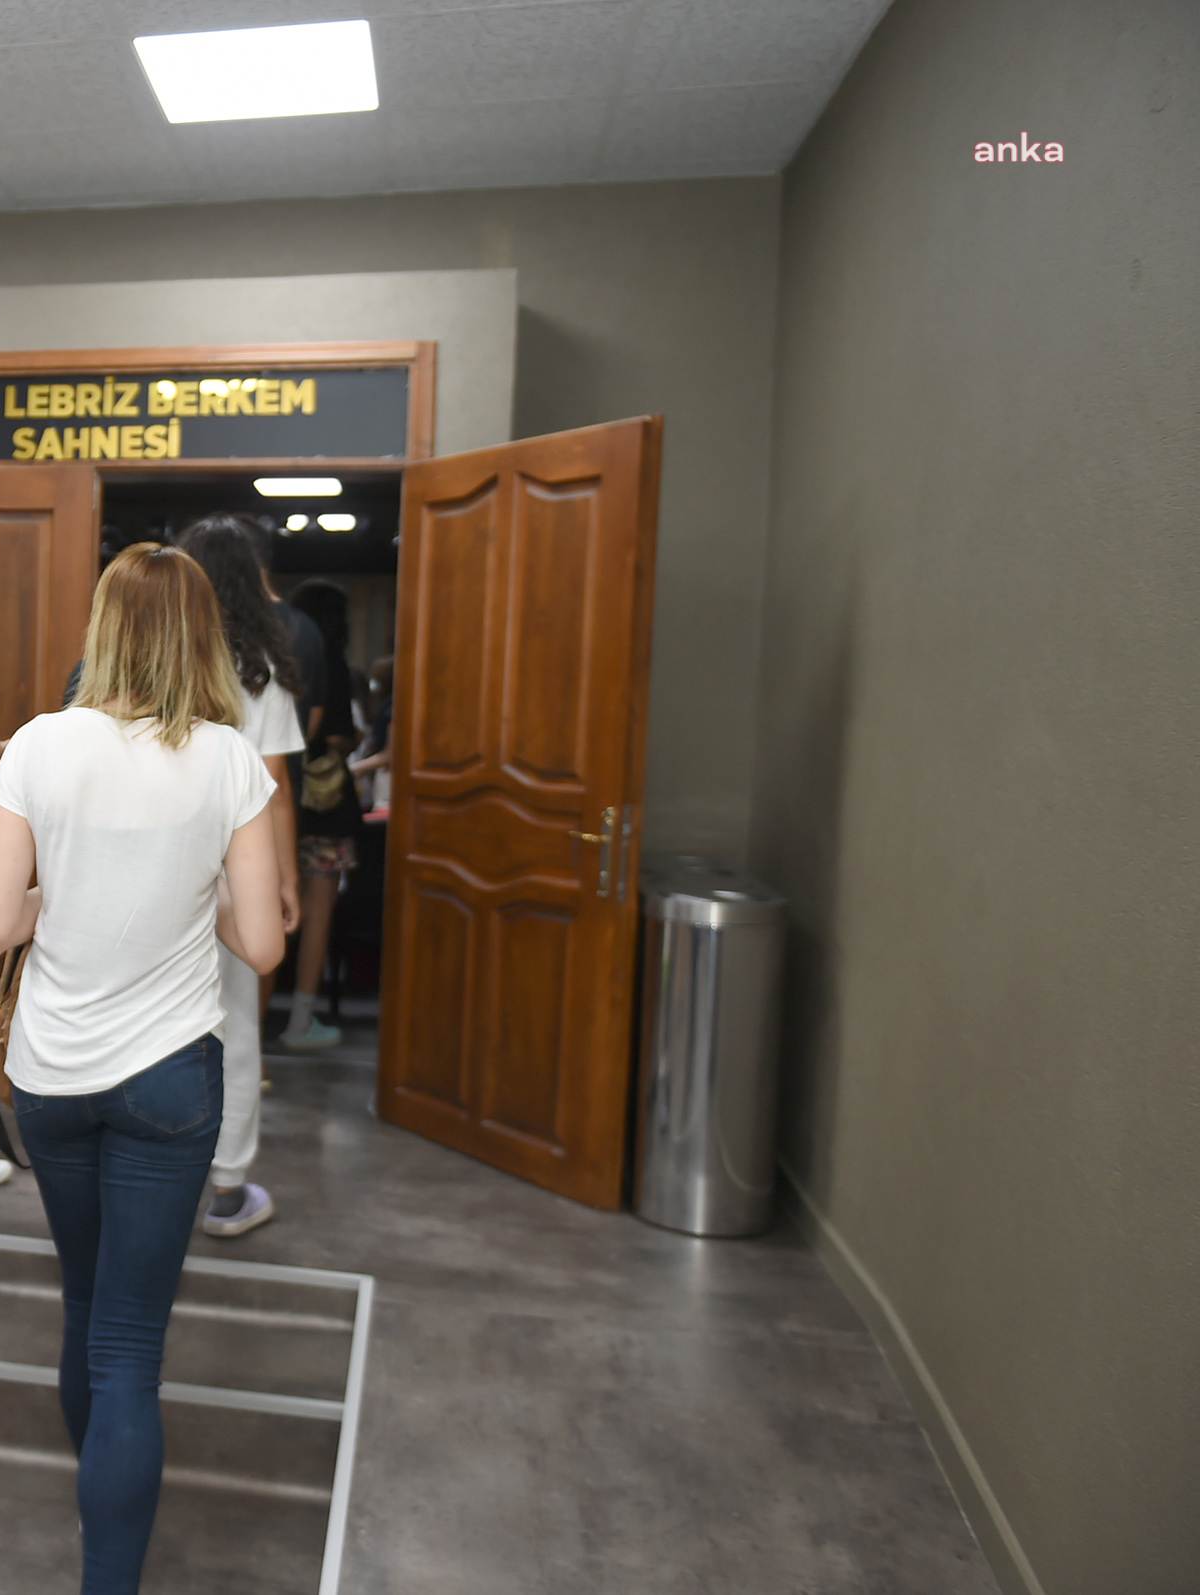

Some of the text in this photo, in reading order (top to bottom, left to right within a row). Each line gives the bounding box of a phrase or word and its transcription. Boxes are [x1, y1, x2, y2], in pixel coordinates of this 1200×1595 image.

[5, 375, 139, 418] LEBRİZ
[147, 378, 316, 417] BERKEM
[11, 417, 182, 460] SAHNESİ
